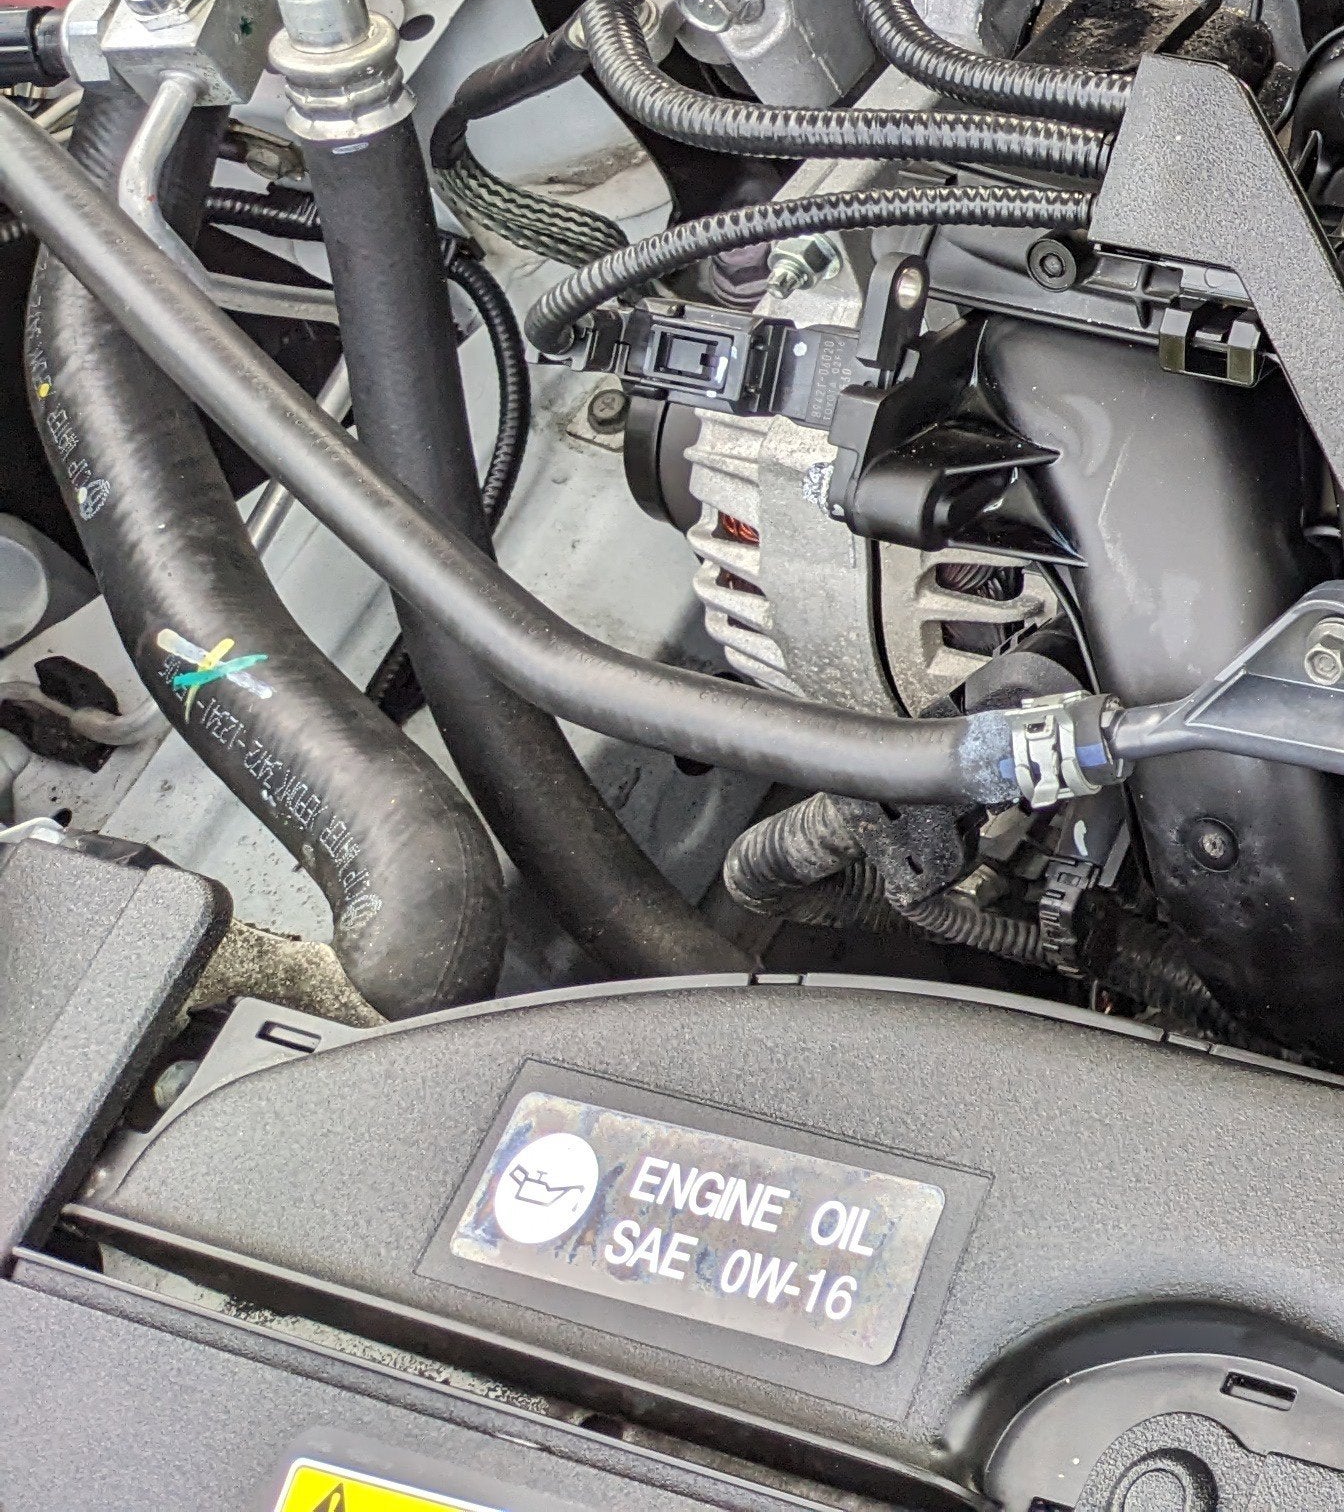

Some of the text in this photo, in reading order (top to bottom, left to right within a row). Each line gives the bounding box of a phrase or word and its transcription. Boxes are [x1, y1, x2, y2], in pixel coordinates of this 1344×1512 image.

[629, 1156, 875, 1257] ENGINE OIL
[605, 1220, 858, 1321] SAE 0W-16
